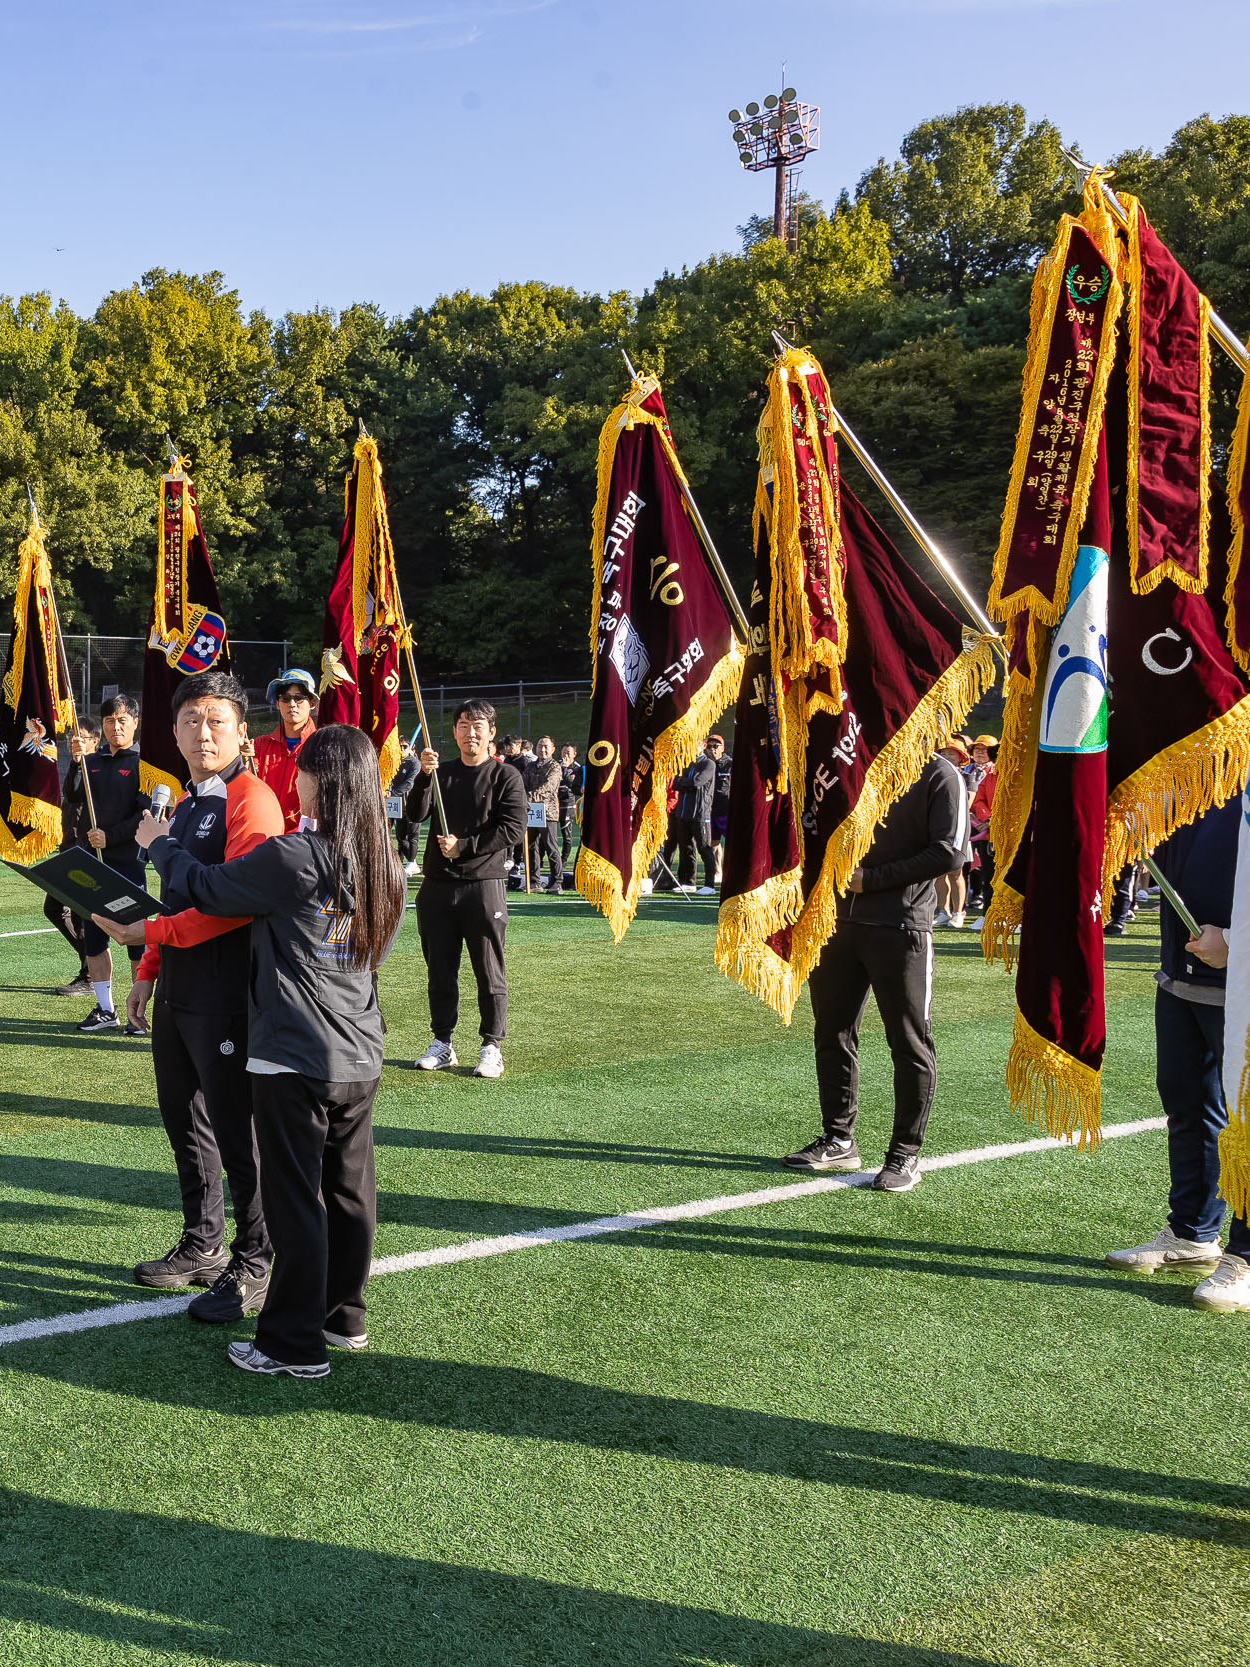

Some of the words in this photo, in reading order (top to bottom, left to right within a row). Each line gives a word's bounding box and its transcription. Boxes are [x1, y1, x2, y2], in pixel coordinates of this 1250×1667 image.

[1072, 275, 1102, 292] 우승
[1064, 308, 1094, 325] 장년부
[1075, 338, 1095, 372] 제22회
[1061, 376, 1090, 446] 광진구청장기
[1052, 451, 1072, 495] 생활체육
[1042, 500, 1064, 546] 축구대회
